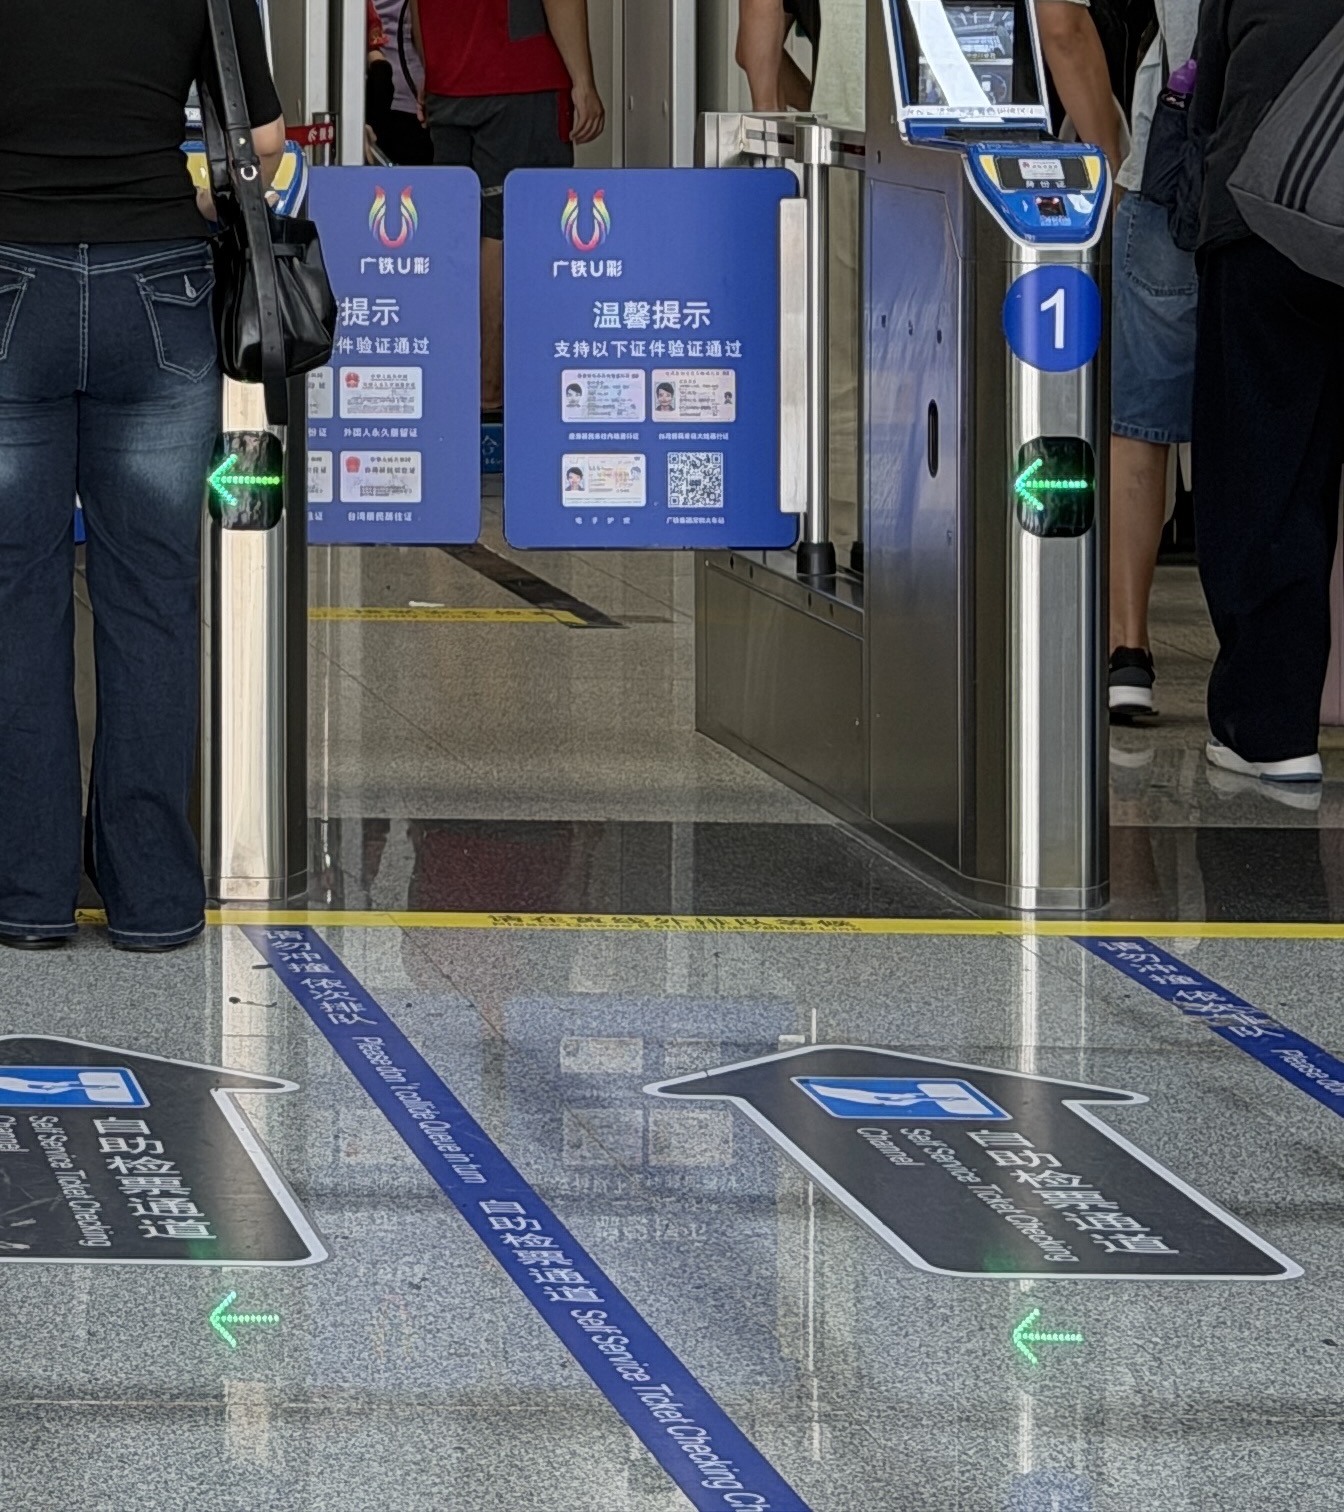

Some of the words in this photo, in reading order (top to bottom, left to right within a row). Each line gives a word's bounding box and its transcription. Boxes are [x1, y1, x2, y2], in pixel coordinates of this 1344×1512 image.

[361, 257, 430, 275] 广铁U彩
[553, 260, 623, 278] 广铁U彩
[337, 297, 400, 326] 提示
[593, 300, 711, 329] 温馨提示
[1040, 288, 1065, 349] 1
[333, 336, 430, 355] 件验证通过
[554, 340, 742, 358] 支持以下证件验证通过
[83, 1117, 216, 1238] 自助检票通道
[952, 1130, 1181, 1253] 自助检票通道
[470, 1200, 607, 1302] 自助检票通道
